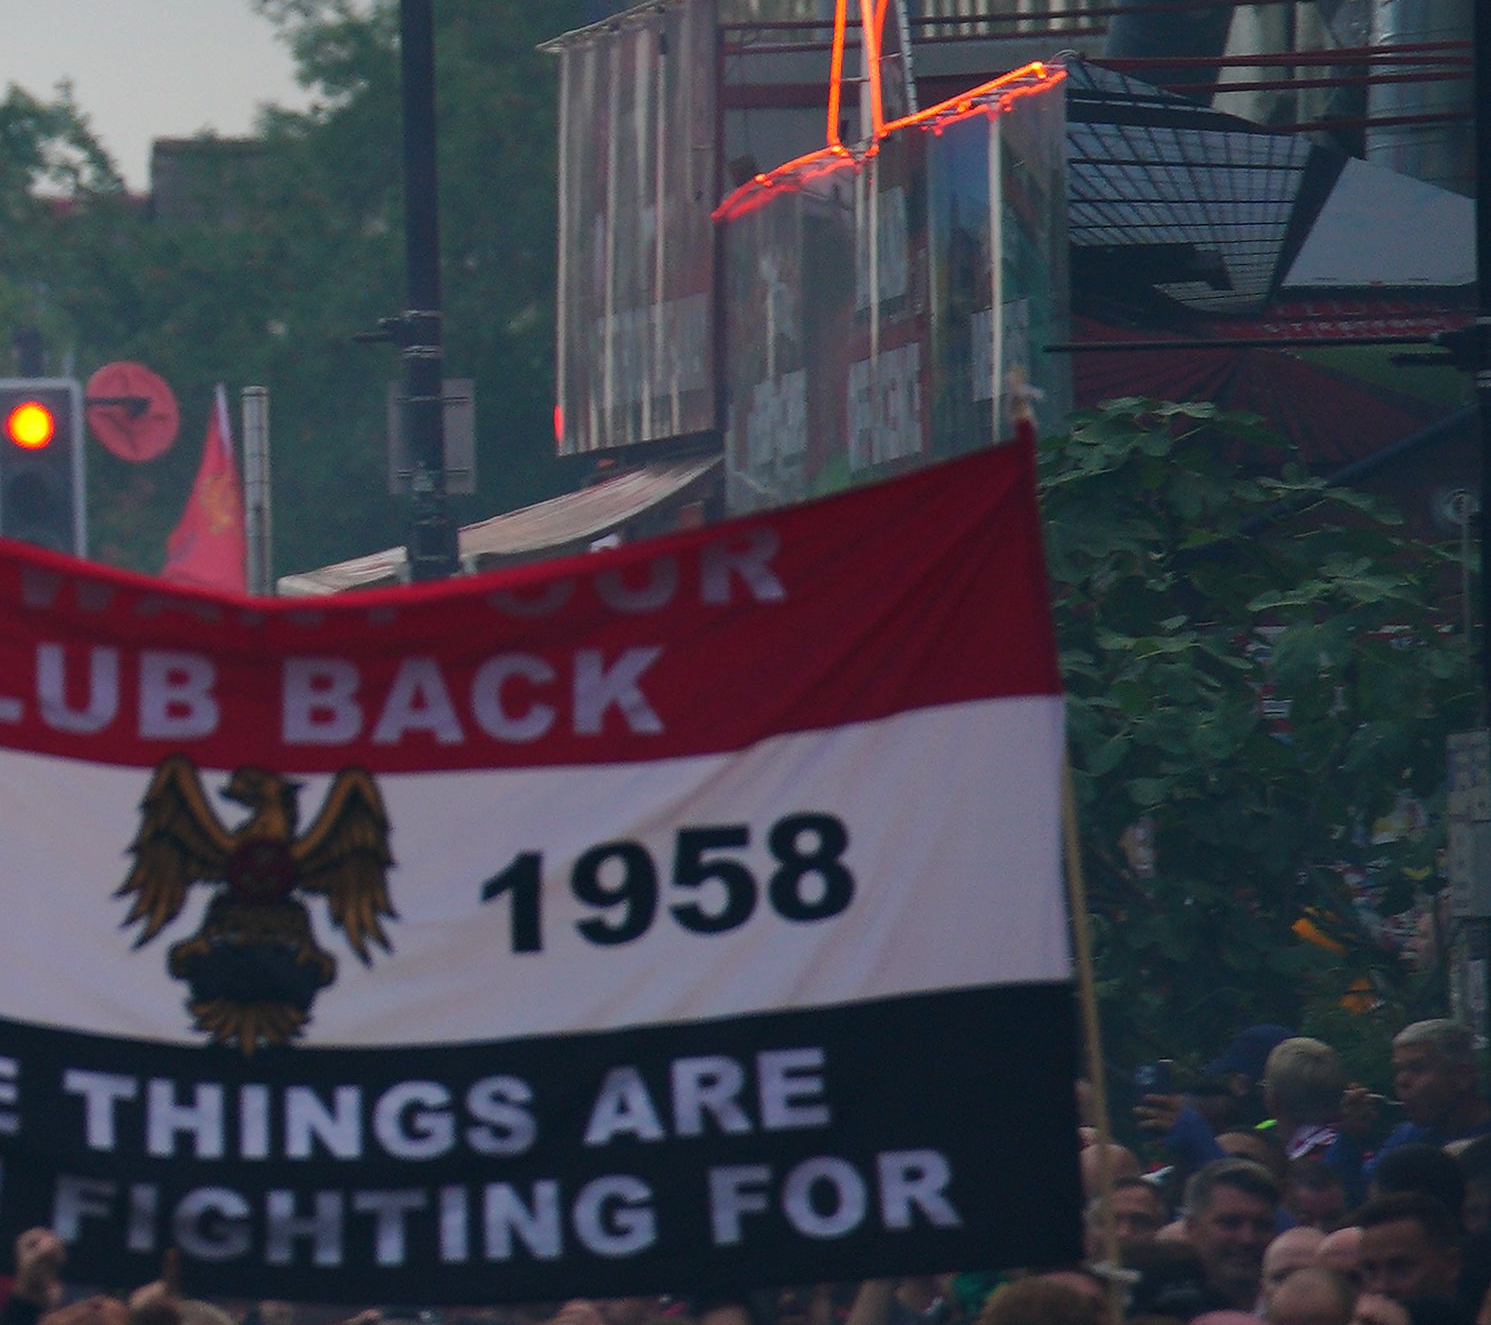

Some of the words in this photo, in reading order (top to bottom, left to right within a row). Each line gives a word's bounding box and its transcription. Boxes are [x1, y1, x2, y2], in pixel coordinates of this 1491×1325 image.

[280, 645, 665, 746] BACK
[479, 811, 858, 956] 1958
[64, 1067, 538, 1161] THINGS
[583, 1047, 832, 1149] ARE
[52, 1167, 658, 1267] FIGHTING
[712, 1147, 964, 1247] FOR
